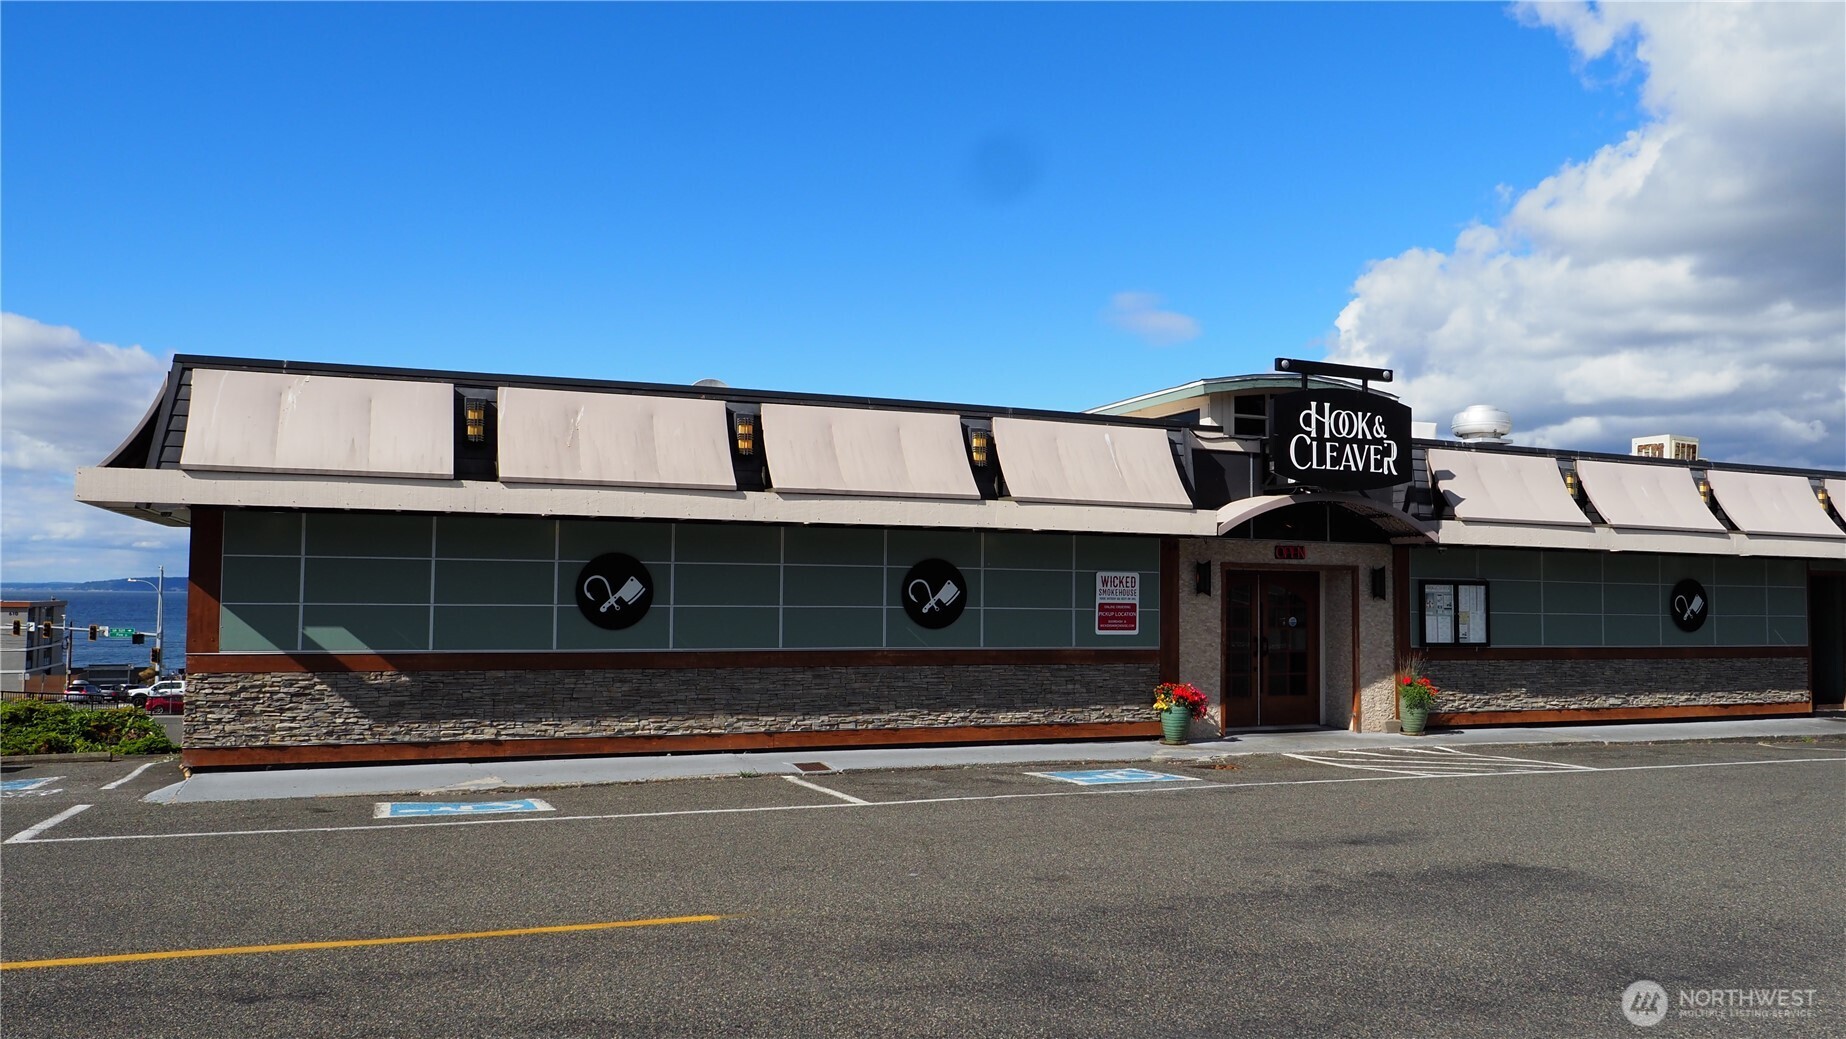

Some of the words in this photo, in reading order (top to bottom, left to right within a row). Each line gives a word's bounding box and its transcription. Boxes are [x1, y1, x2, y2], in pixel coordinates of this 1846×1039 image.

[1289, 433, 1398, 475] CLEAVER
[1100, 575, 1136, 588] WICKED
[1098, 588, 1137, 597] SMOKEHOUSE
